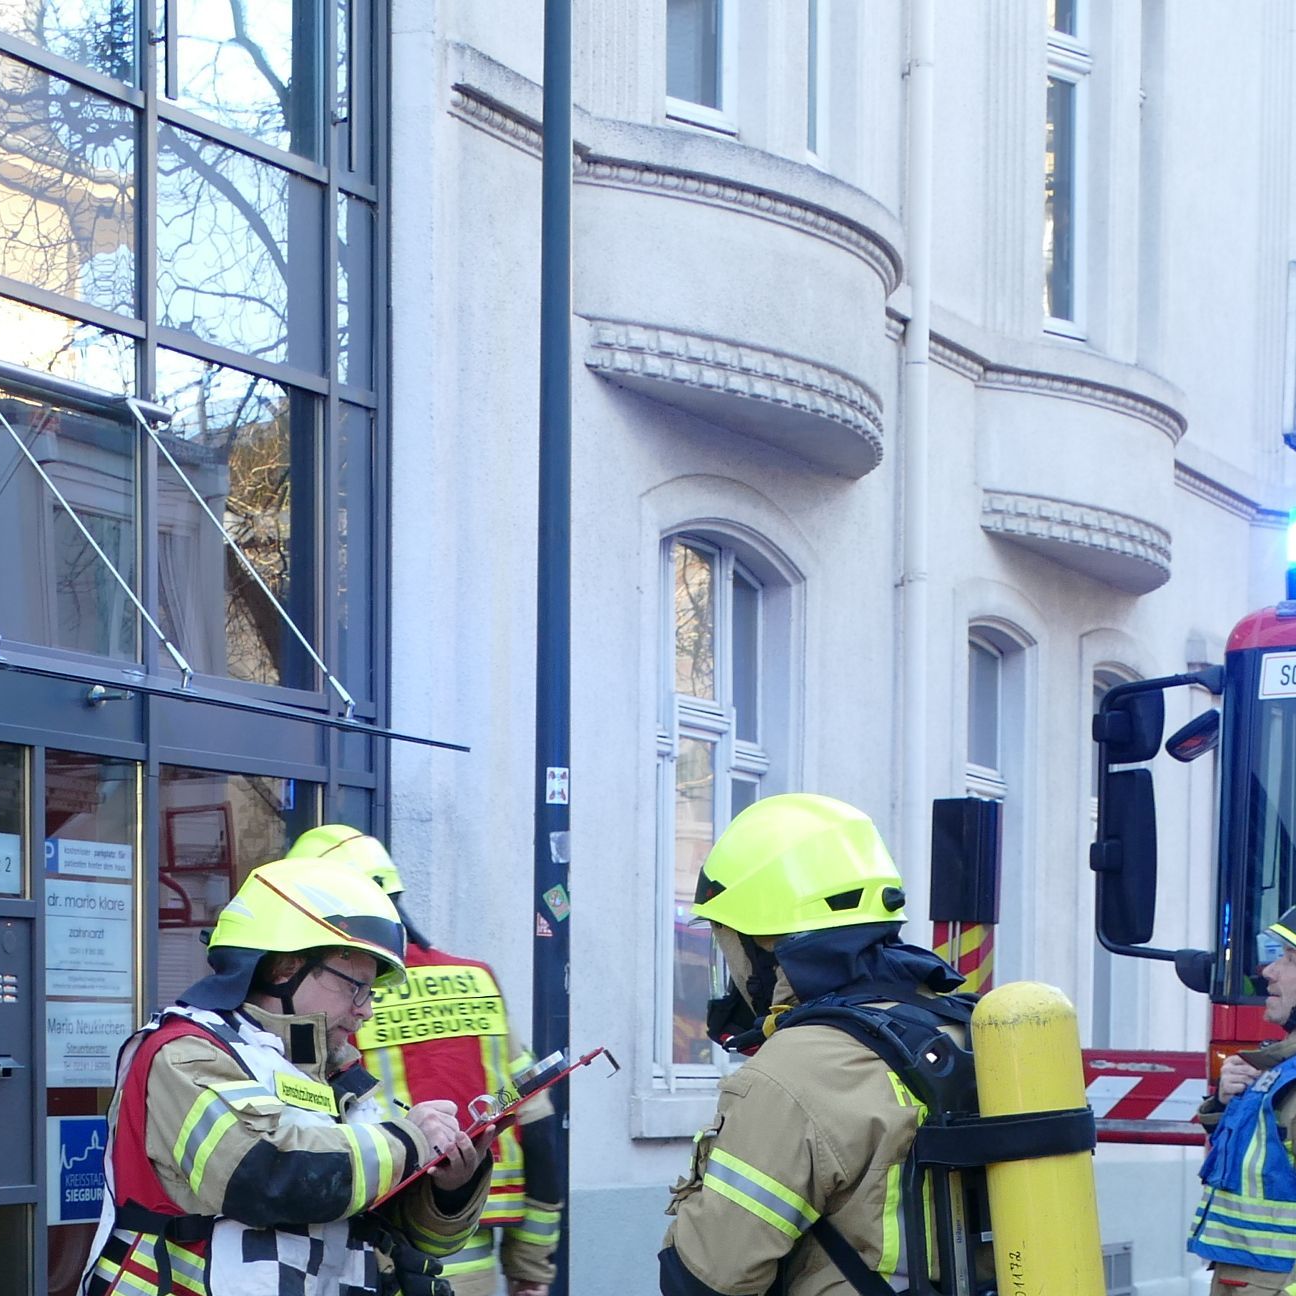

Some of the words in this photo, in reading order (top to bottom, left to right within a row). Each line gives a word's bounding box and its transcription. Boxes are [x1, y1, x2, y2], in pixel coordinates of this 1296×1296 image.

[5, 856, 12, 873] 2
[47, 893, 63, 907] dr.
[64, 895, 97, 910] mario
[99, 897, 126, 911] klare
[68, 928, 105, 939] zahnarzt
[363, 1001, 499, 1028] EUERWEHR
[47, 1018, 74, 1034] Mario
[76, 1020, 126, 1035] Neukirchen
[376, 1017, 490, 1042] SIEGBURG
[65, 1173, 104, 1187] KREISSTAD
[65, 1188, 104, 1202] SIEGBUR
